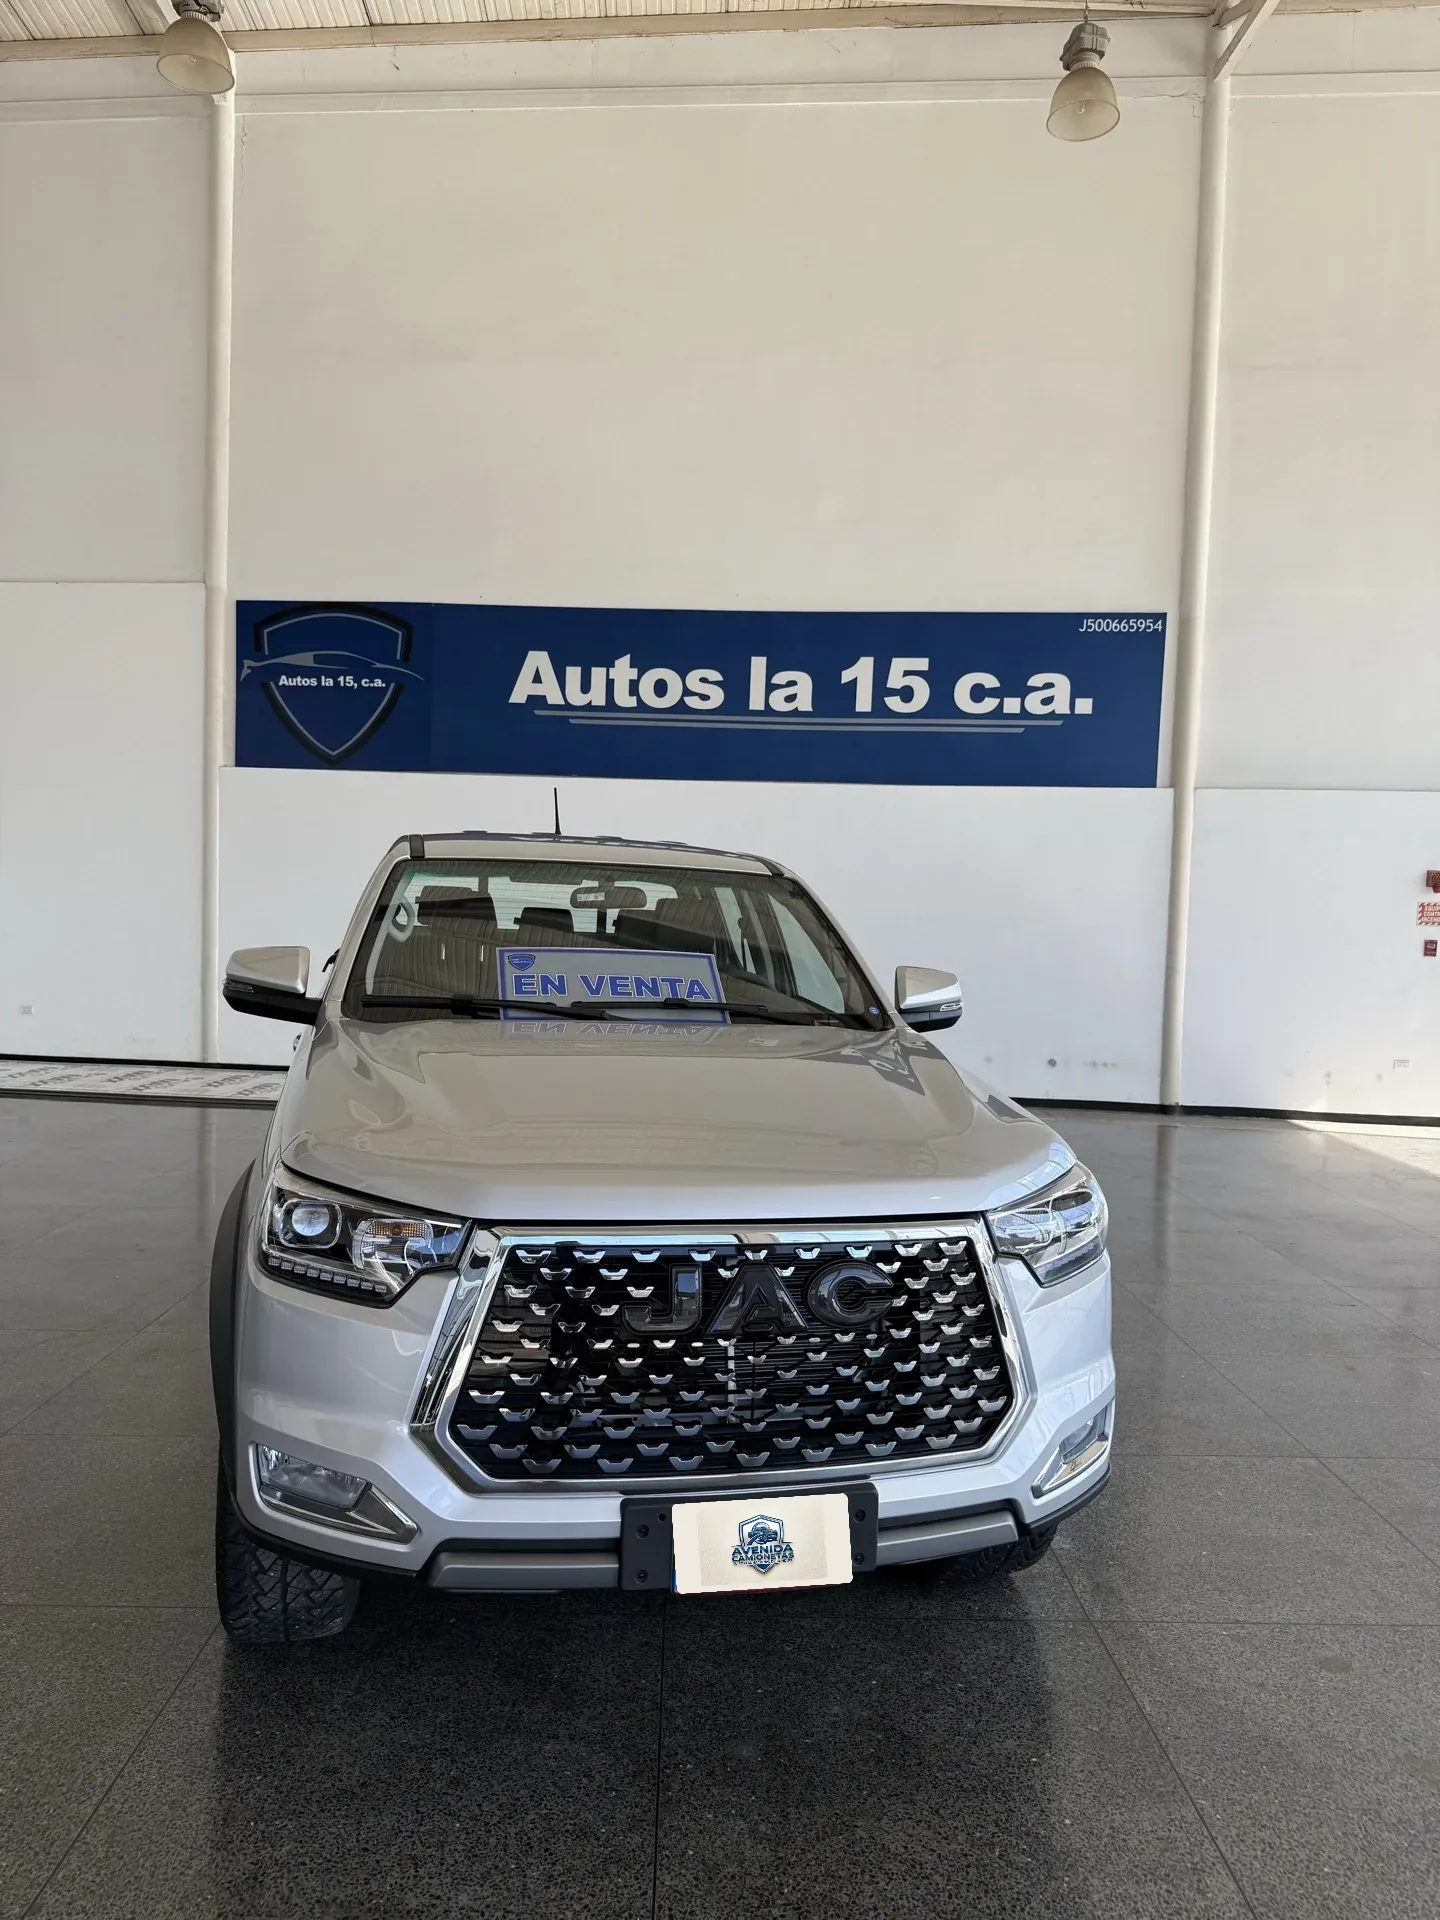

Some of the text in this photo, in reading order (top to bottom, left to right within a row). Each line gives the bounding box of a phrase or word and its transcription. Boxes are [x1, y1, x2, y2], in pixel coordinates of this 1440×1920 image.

[1078, 618, 1163, 633] J500665954
[278, 675, 386, 690] Autos la 15, c.a.
[508, 650, 1093, 715] Autos la 15 c.a.
[512, 974, 713, 1001] EN VENTA
[619, 1259, 895, 1336] JAC
